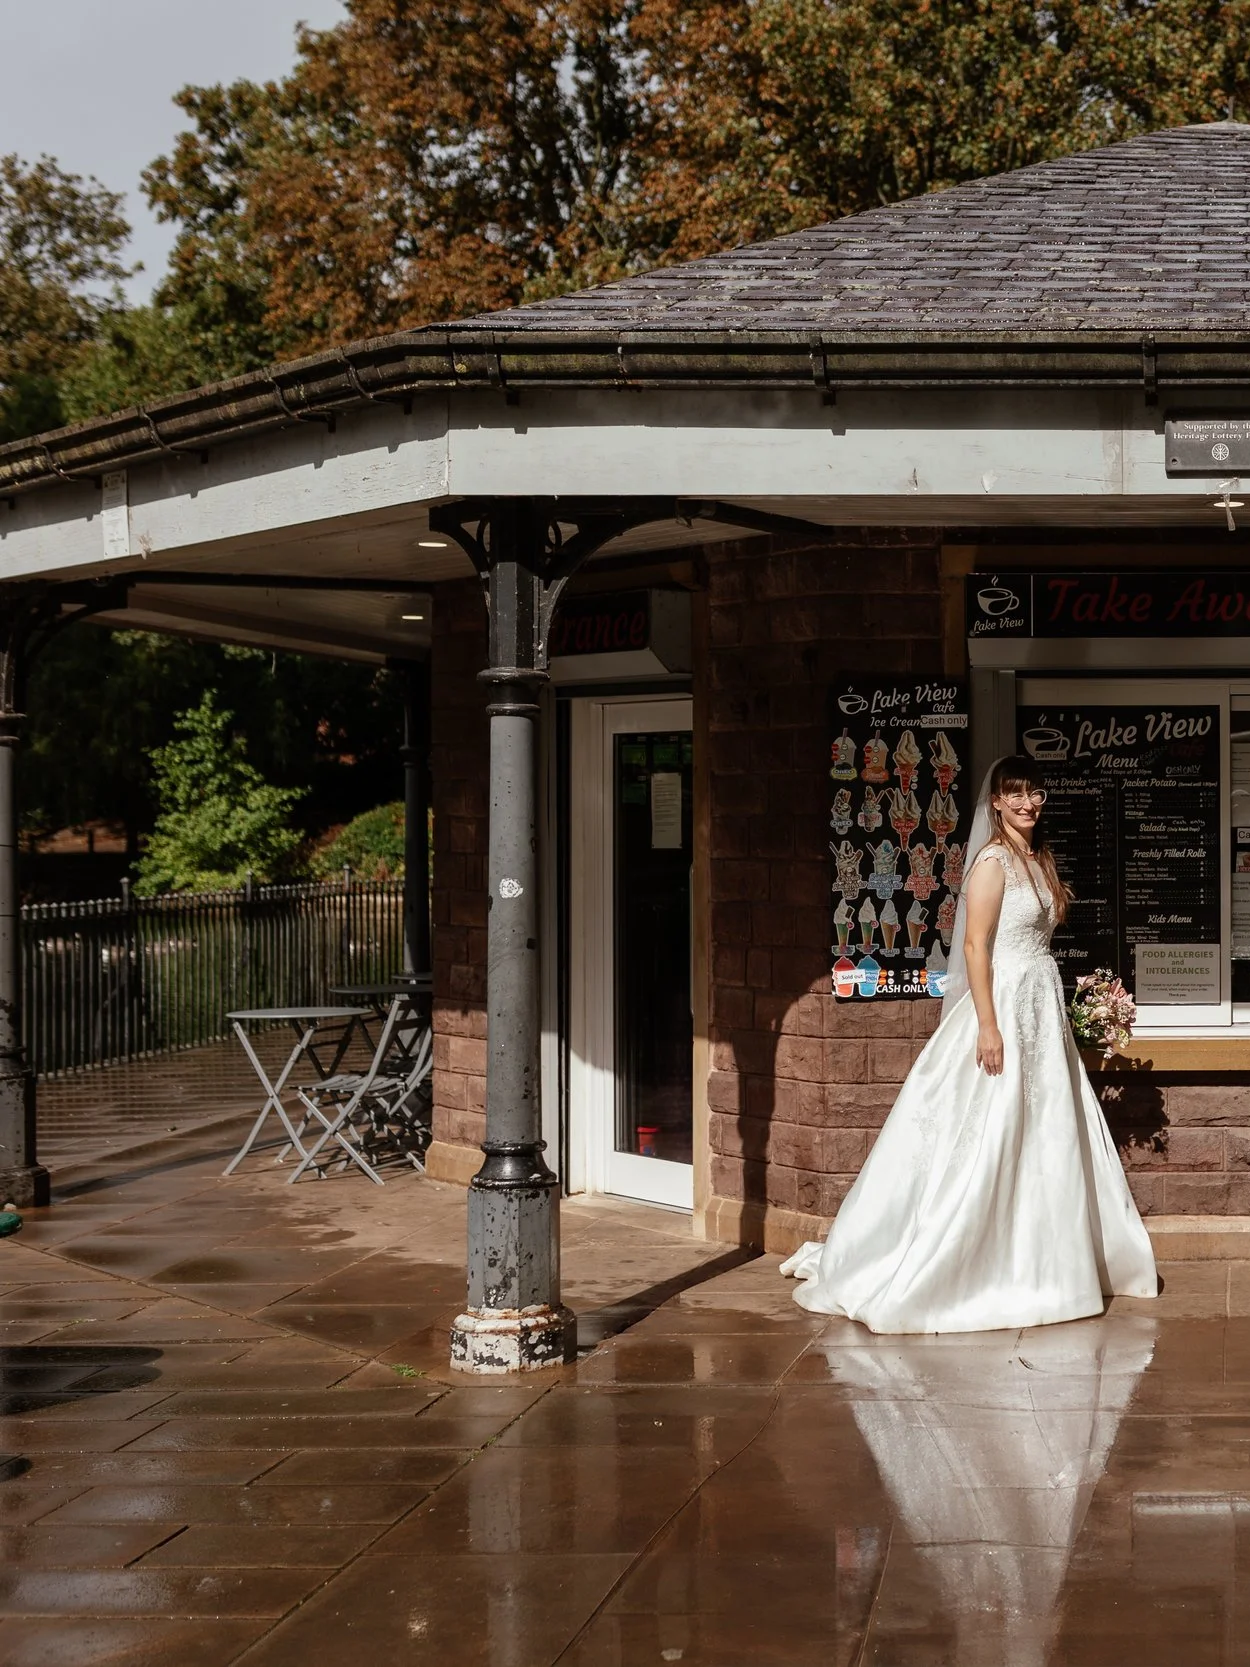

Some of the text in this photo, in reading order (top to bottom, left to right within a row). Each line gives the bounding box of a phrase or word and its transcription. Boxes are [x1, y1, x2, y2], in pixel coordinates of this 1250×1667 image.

[1184, 423, 1227, 432] Supported
[1229, 423, 1240, 432] by
[1173, 432, 1209, 441] Heritage
[1212, 432, 1242, 441] Lottery
[1046, 577, 1152, 622] Take
[972, 617, 1025, 634] Lake View
[870, 682, 958, 713] Lake View
[870, 716, 886, 728] Ice
[921, 715, 967, 726] Cash only
[1074, 716, 1137, 758] Lake
[1145, 711, 1212, 742] View
[1052, 752, 1065, 760] only
[1094, 754, 1140, 768] Menu
[1044, 778, 1060, 787] Hot
[1061, 777, 1087, 787] Drinks
[1121, 778, 1149, 790] Jacket
[1150, 778, 1177, 787] Potato
[1084, 788, 1102, 796] Coffee
[1139, 822, 1167, 832] Salads
[1132, 848, 1207, 860] Freshly Filled Rolls
[1147, 914, 1193, 924] Kids Menu
[1050, 949, 1089, 960] ight Bites
[1146, 967, 1210, 975] INTOLERANCES
[876, 984, 928, 993] CASH ONLY
